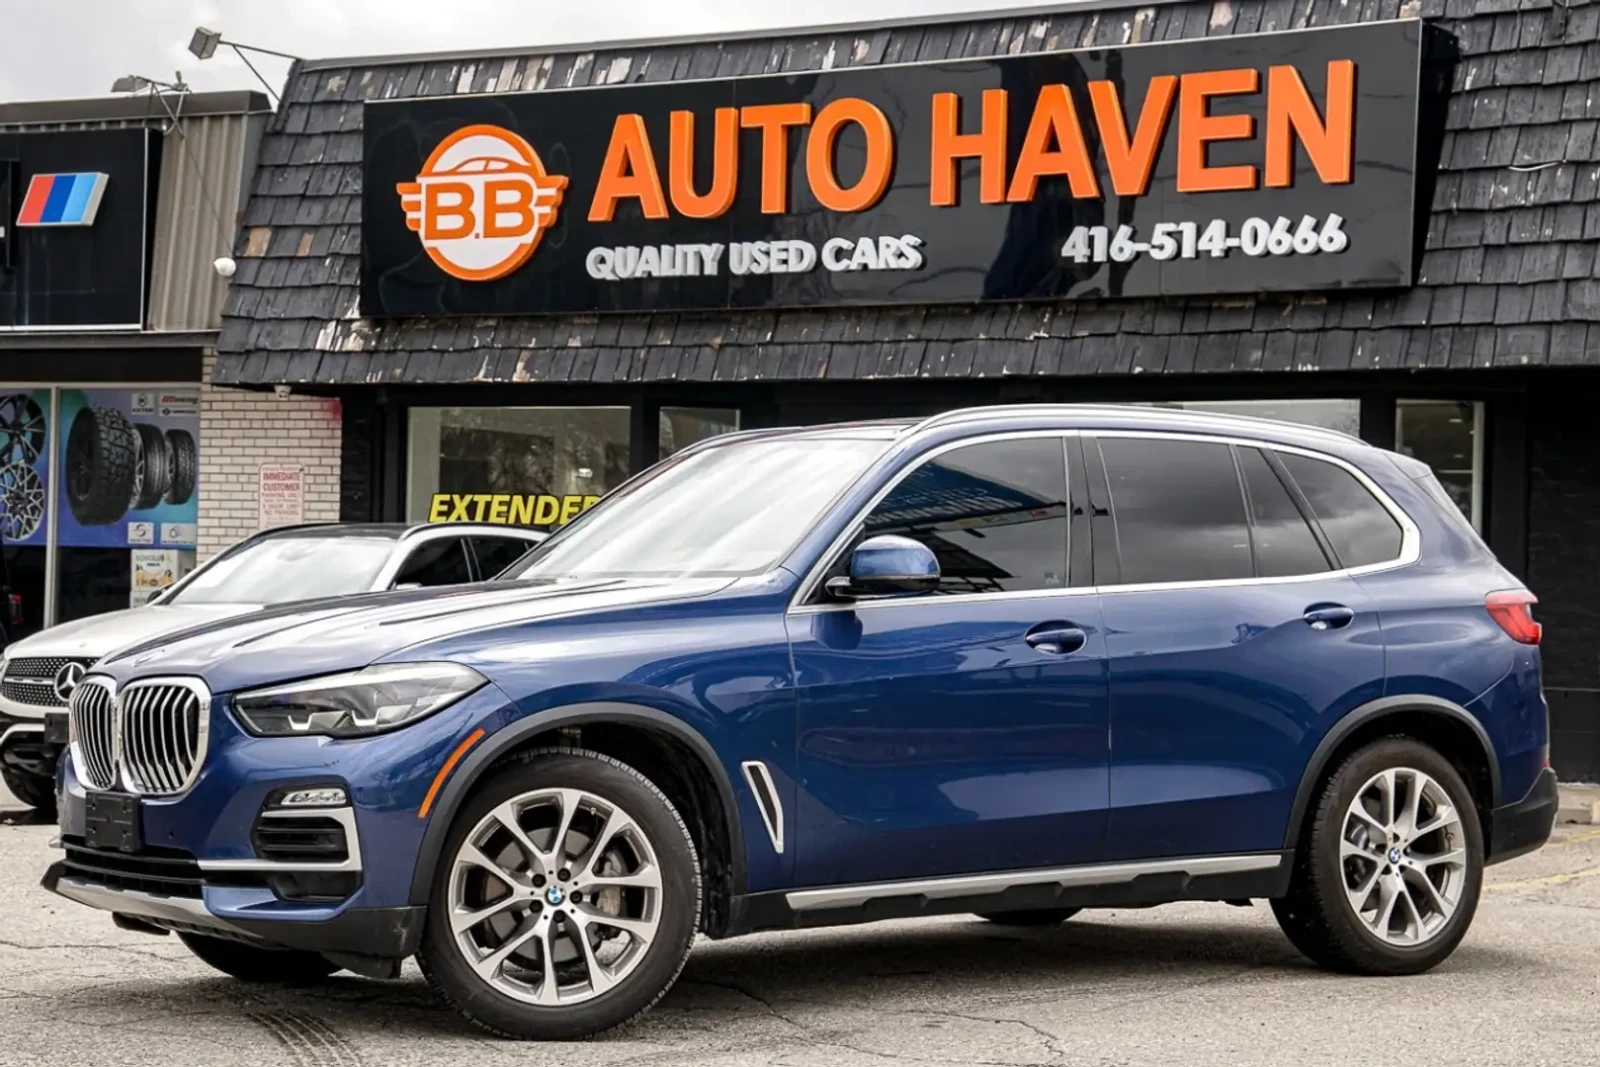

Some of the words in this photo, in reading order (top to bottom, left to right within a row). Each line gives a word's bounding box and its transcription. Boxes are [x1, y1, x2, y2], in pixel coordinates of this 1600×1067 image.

[587, 98, 893, 221] AUTO
[930, 59, 1354, 206] HAVEN
[586, 243, 724, 281] QUALITY
[729, 239, 817, 275] USED
[821, 234, 923, 272] CARS
[1061, 212, 1348, 264] 416-514-0666
[263, 472, 301, 481] IMMEDIATE
[263, 483, 300, 491] CUSTOMER
